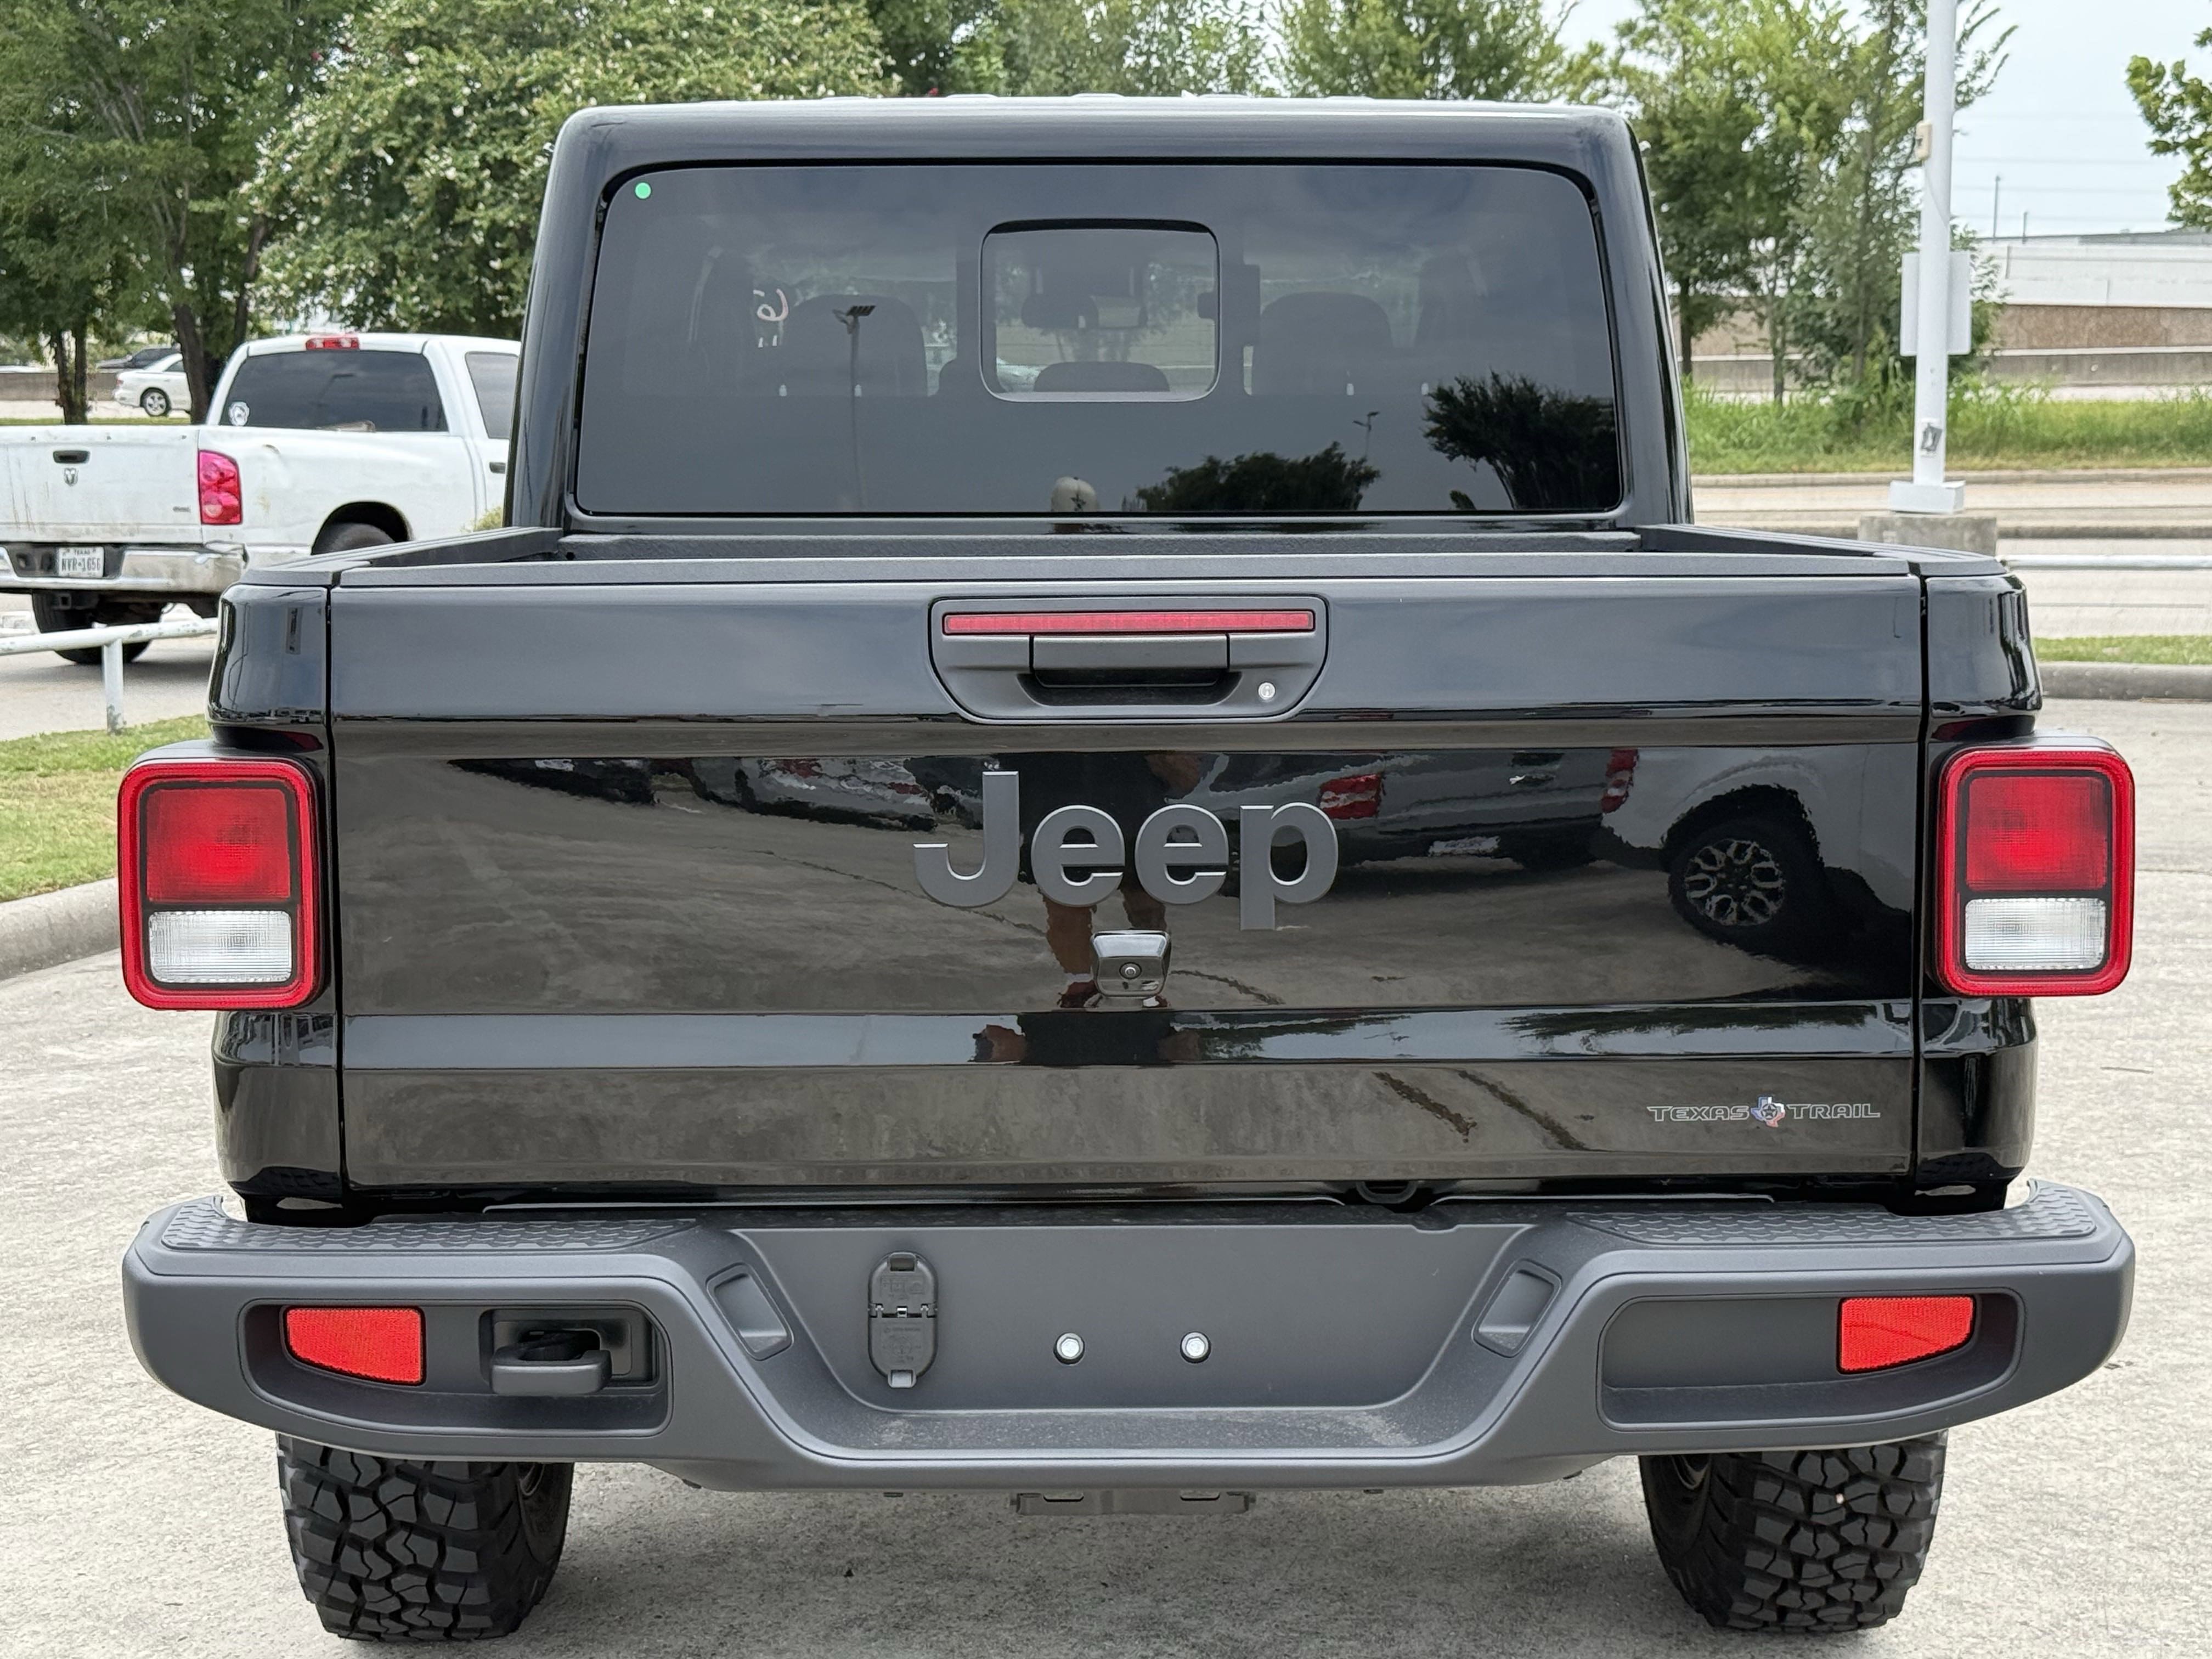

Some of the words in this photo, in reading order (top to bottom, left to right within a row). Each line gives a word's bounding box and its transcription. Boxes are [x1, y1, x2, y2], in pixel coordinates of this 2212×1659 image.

[913, 770, 1339, 931] Jeep
[1646, 1105, 1750, 1122] TEXAS
[1787, 1103, 1881, 1120] TRAIL
